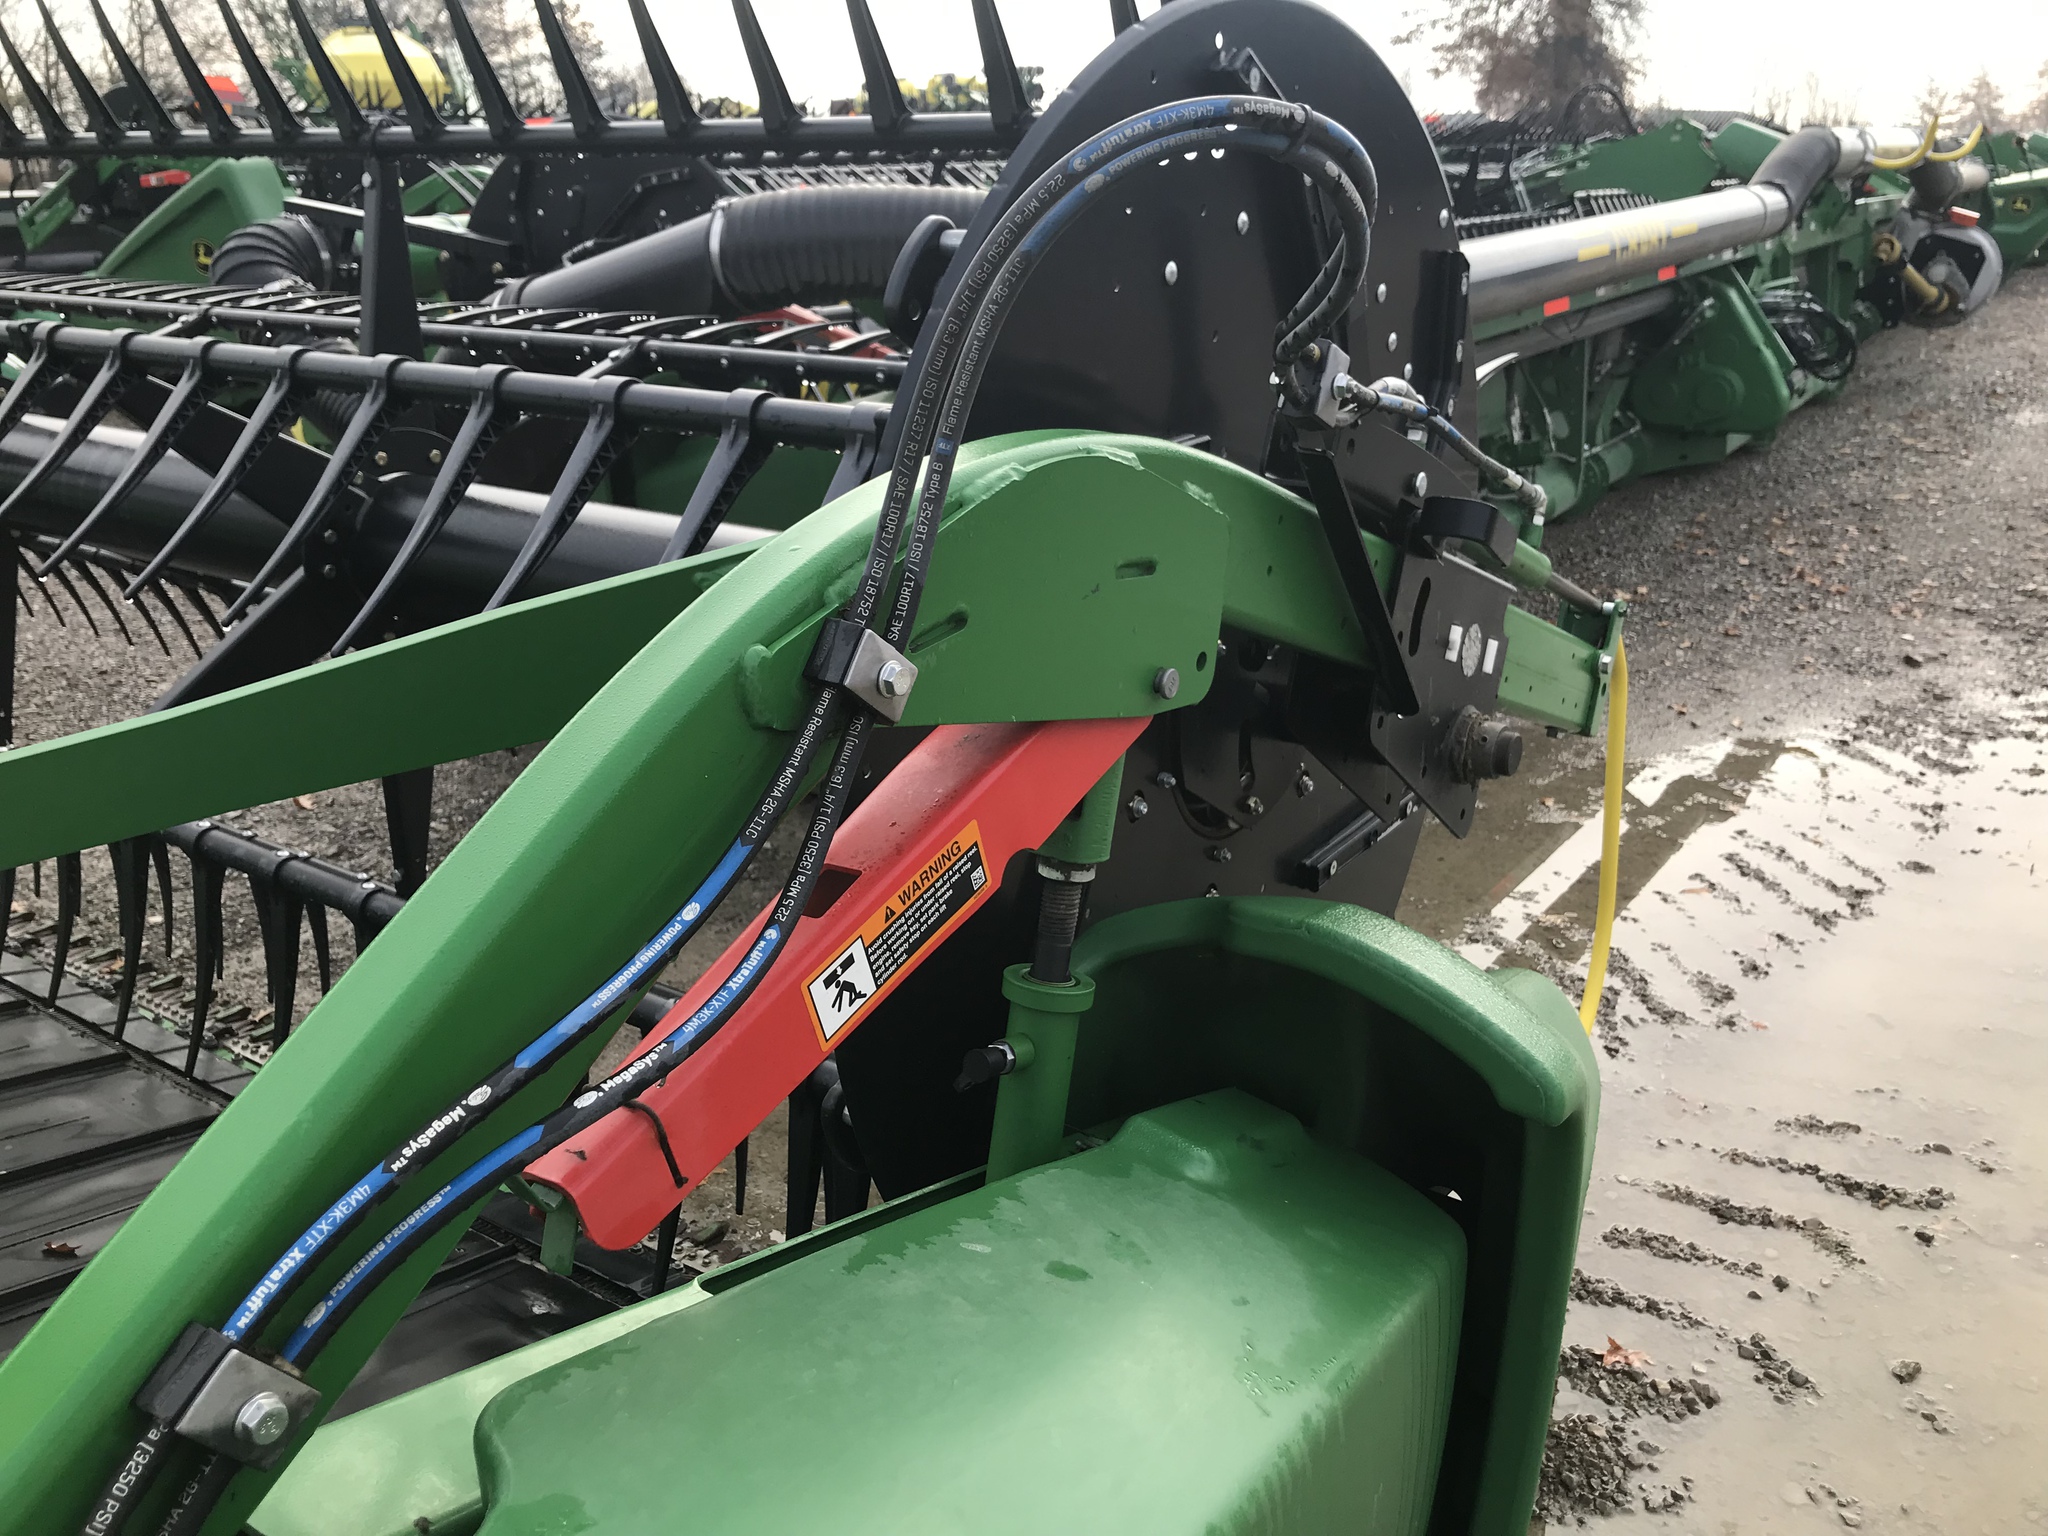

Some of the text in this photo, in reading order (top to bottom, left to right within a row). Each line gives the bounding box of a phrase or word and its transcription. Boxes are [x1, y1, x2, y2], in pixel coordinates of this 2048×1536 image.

[1156, 104, 1214, 131] 4M3K-XTF
[1108, 142, 1160, 174] POWERING
[1039, 174, 1065, 200] 22.5
[1015, 199, 1040, 225] MPa
[942, 257, 1025, 435] Flame Resistant MSHA 2G-11C
[923, 377, 939, 399] ISO
[911, 400, 930, 439] 11237
[903, 441, 918, 466] R17
[934, 462, 944, 471] B
[893, 475, 909, 500] SAE
[925, 472, 941, 500] Type
[881, 501, 901, 548] 100R17
[915, 501, 934, 540] 18752
[871, 555, 887, 578] ISO
[910, 541, 923, 564] ISO
[857, 578, 879, 617] 18752
[896, 571, 915, 617] 100R17
[888, 620, 904, 641] SAE
[814, 687, 837, 715] lame
[788, 716, 823, 766] Resistant
[771, 766, 796, 798] MSHA
[746, 797, 778, 839] 2G-11C
[898, 840, 961, 906] WARNING
[774, 898, 795, 922] 22.5
[787, 874, 806, 898] MPa
[867, 937, 883, 955] Avoid
[882, 915, 905, 940] crushing
[905, 898, 923, 919] injuries
[923, 887, 935, 900] from
[935, 878, 944, 889] fall
[952, 856, 968, 873] raised
[869, 943, 887, 962] Before
[887, 922, 908, 945] working
[907, 916, 915, 926] on
[920, 897, 935, 913] under
[935, 881, 950, 900] raised
[960, 861, 972, 874] stop
[891, 932, 910, 951] remove
[920, 912, 928, 923] set
[928, 903, 940, 917] park
[939, 888, 953, 904] brake
[642, 922, 683, 964] POWERING
[874, 903, 947, 978] and set safety stop on each lift
[877, 962, 898, 985] cylinder
[682, 989, 730, 1034] 4M3K-XTF
[305, 1184, 371, 1251] 4M3K-XTF
[330, 1241, 386, 1297] POWERING
